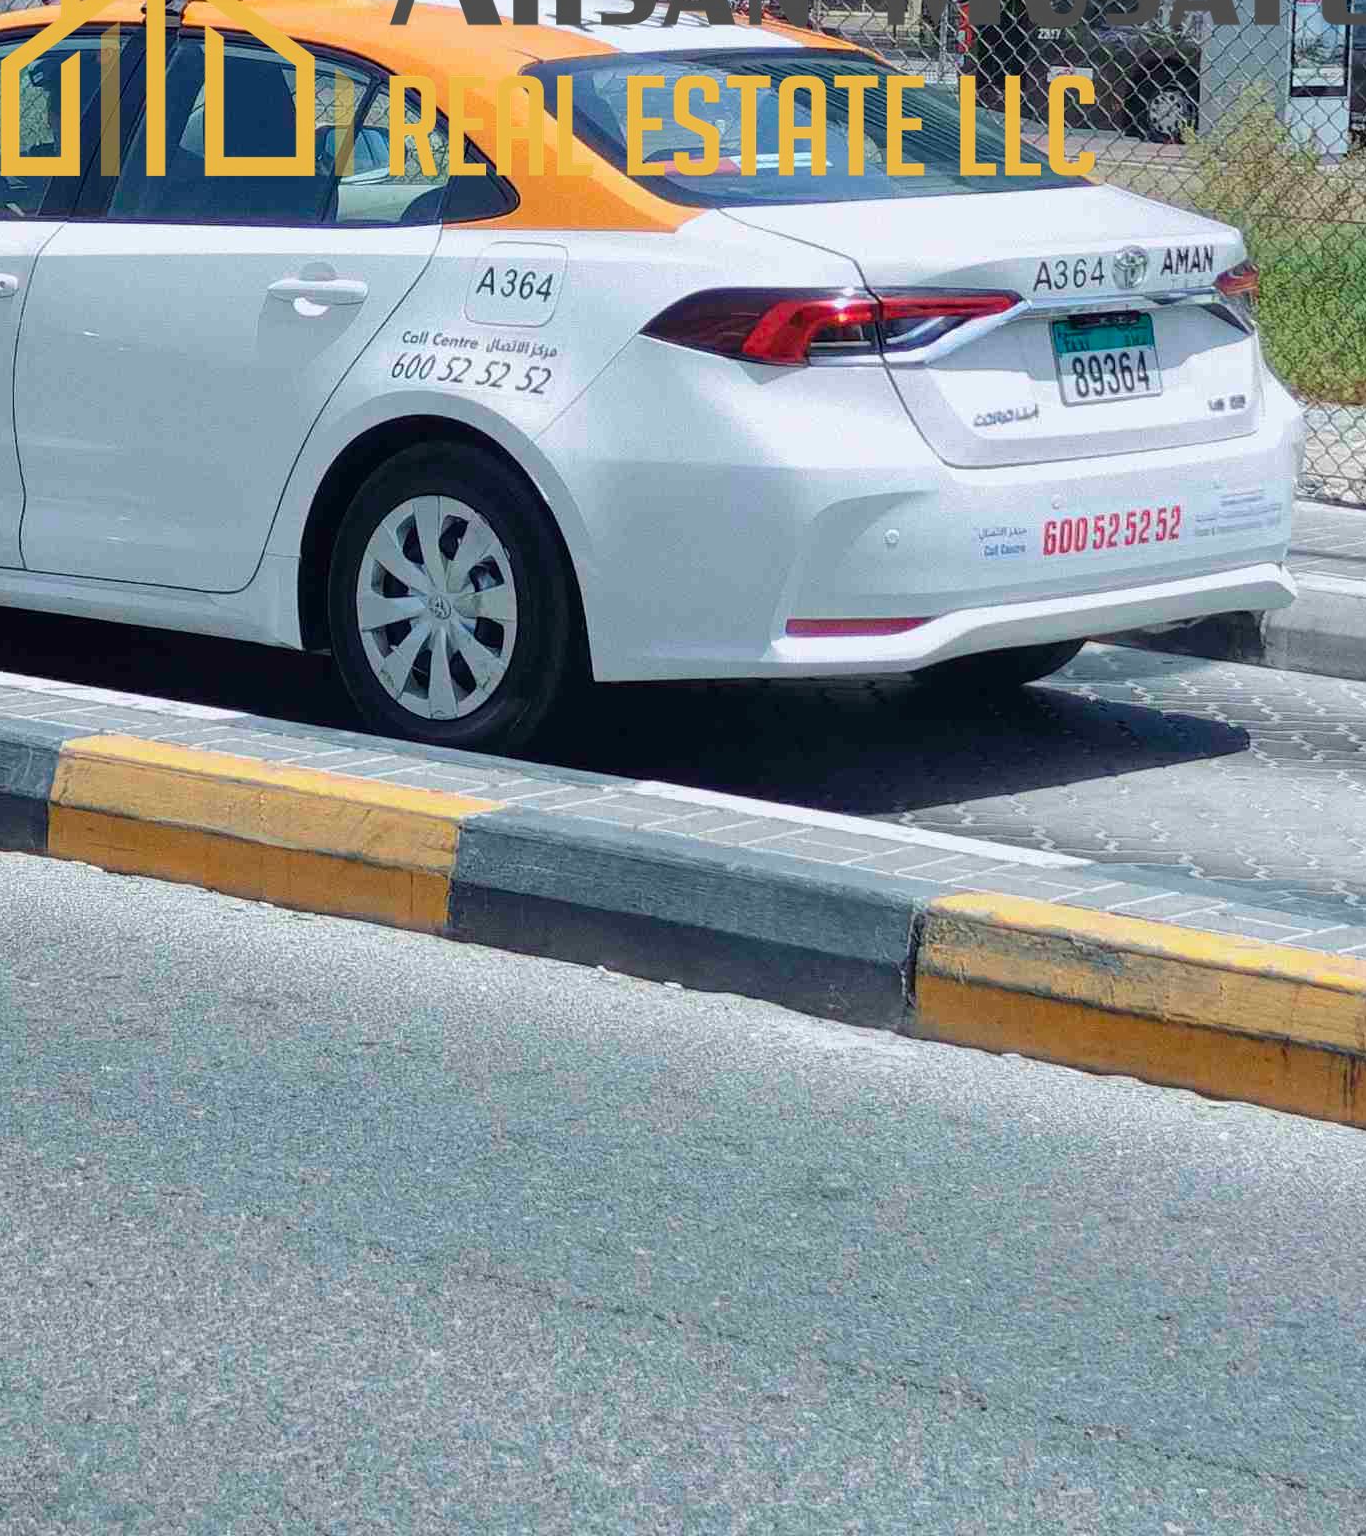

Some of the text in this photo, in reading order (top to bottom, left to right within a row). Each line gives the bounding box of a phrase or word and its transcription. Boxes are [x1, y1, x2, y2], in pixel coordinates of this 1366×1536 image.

[1032, 258, 1106, 293] A364
[1159, 244, 1215, 276] AMAN
[402, 330, 479, 350] Call Centre
[528, 341, 558, 360] مركز
[391, 352, 553, 395] 600 52 52 52
[1071, 350, 1151, 399] 89364
[973, 404, 1040, 427] COROLLA
[1042, 516, 1087, 556] 600
[1092, 512, 1121, 551] 52
[1124, 508, 1152, 546] 52
[1155, 504, 1181, 542] 52
